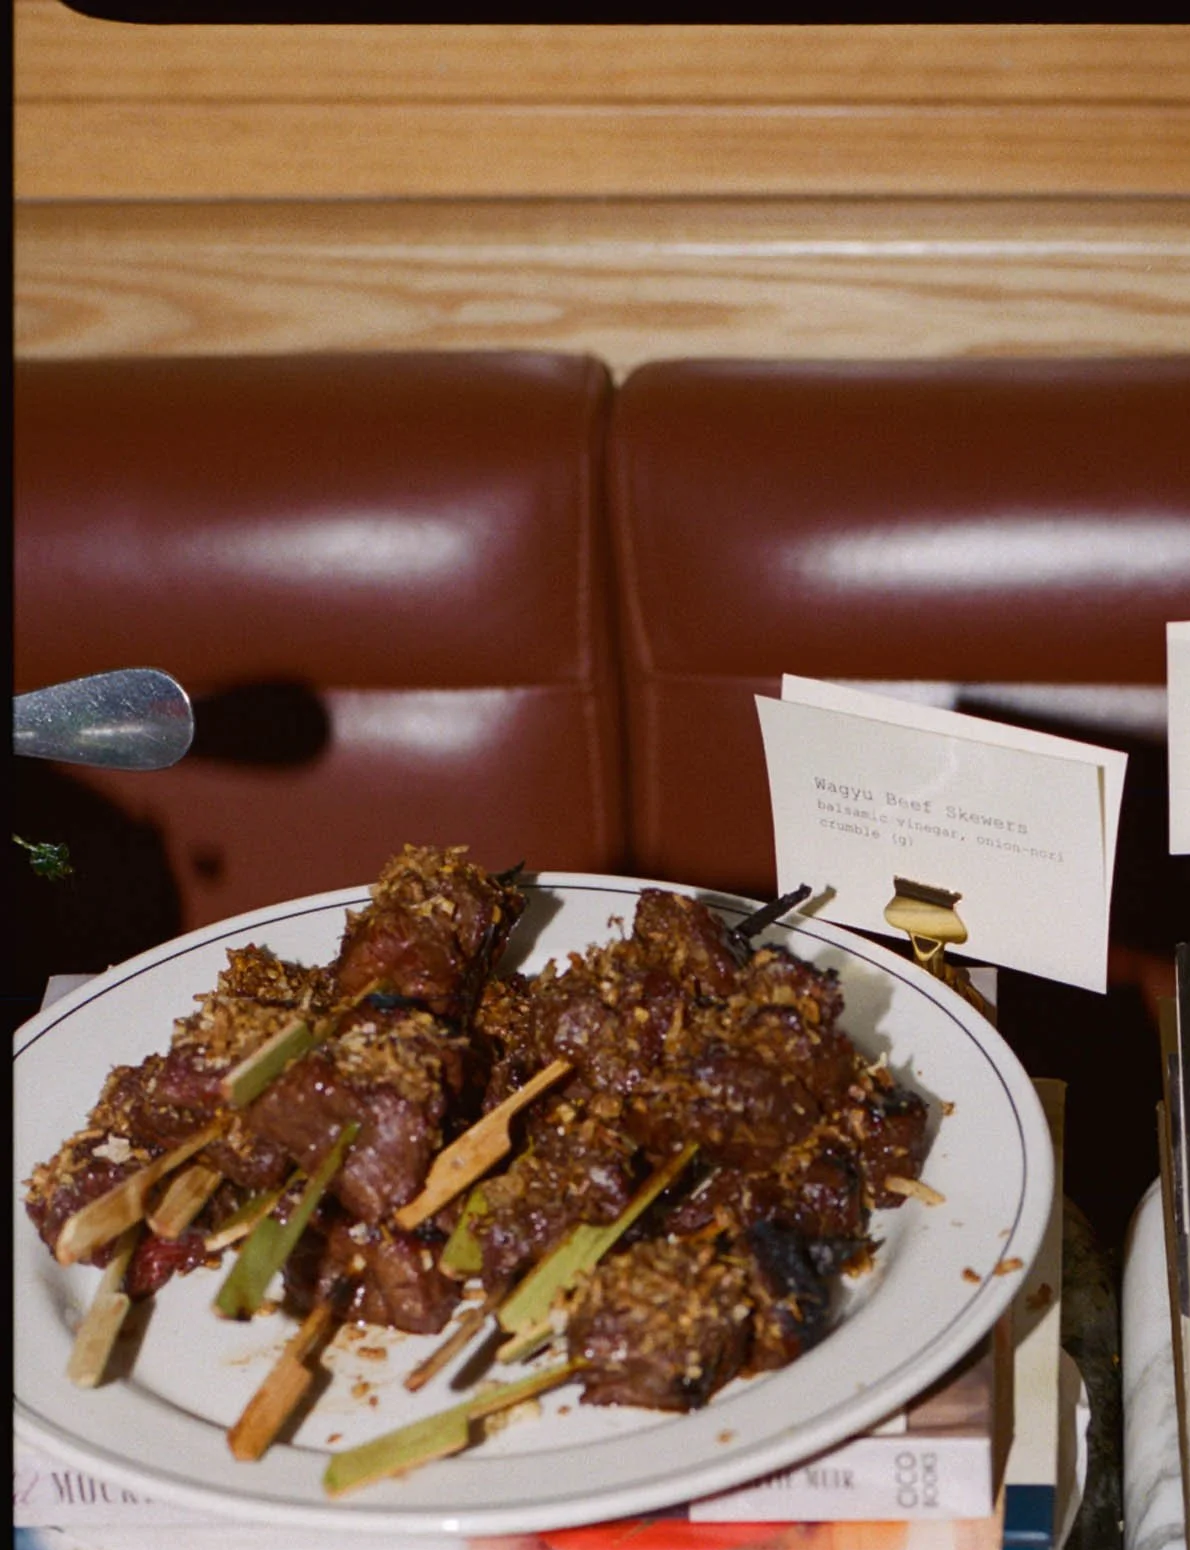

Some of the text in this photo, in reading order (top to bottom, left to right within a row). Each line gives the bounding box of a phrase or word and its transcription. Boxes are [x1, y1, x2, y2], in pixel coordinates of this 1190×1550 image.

[813, 775, 1029, 835] Wagyu Beef Skewers
[816, 798, 889, 825] balsamic
[818, 817, 881, 840] crumble
